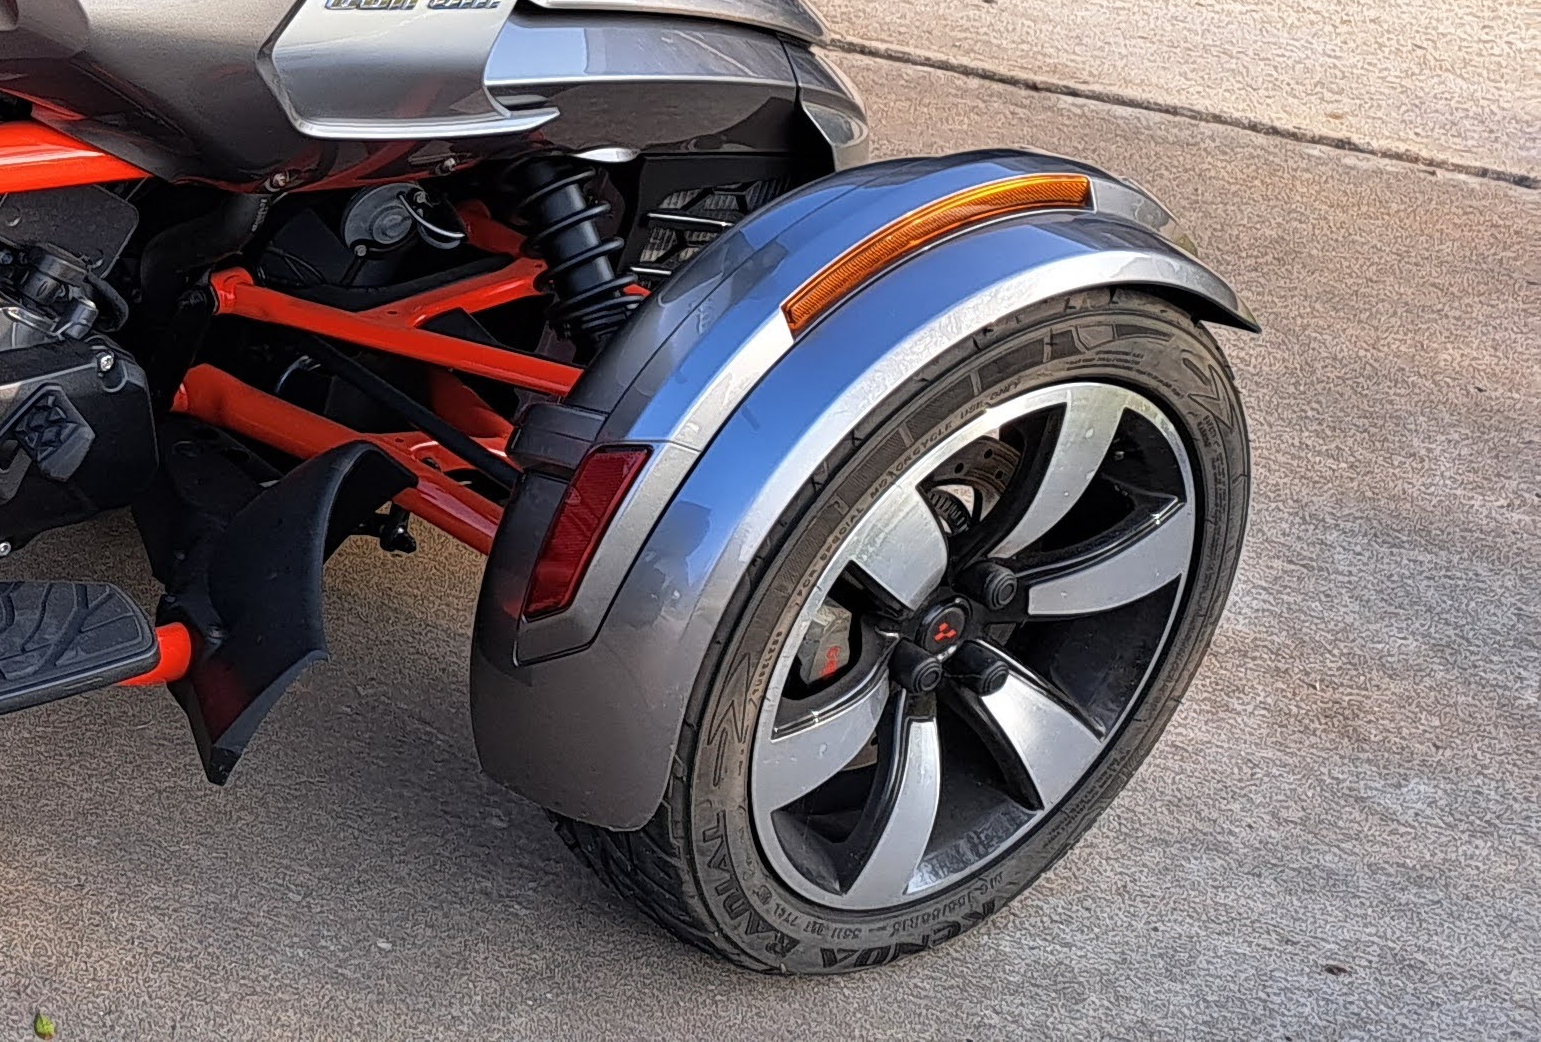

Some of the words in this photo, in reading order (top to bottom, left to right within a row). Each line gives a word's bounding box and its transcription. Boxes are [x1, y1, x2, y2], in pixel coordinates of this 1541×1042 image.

[870, 422, 953, 500] MOTORCYCLE
[702, 809, 801, 958] RADIAL
[819, 898, 997, 968] KENDA
